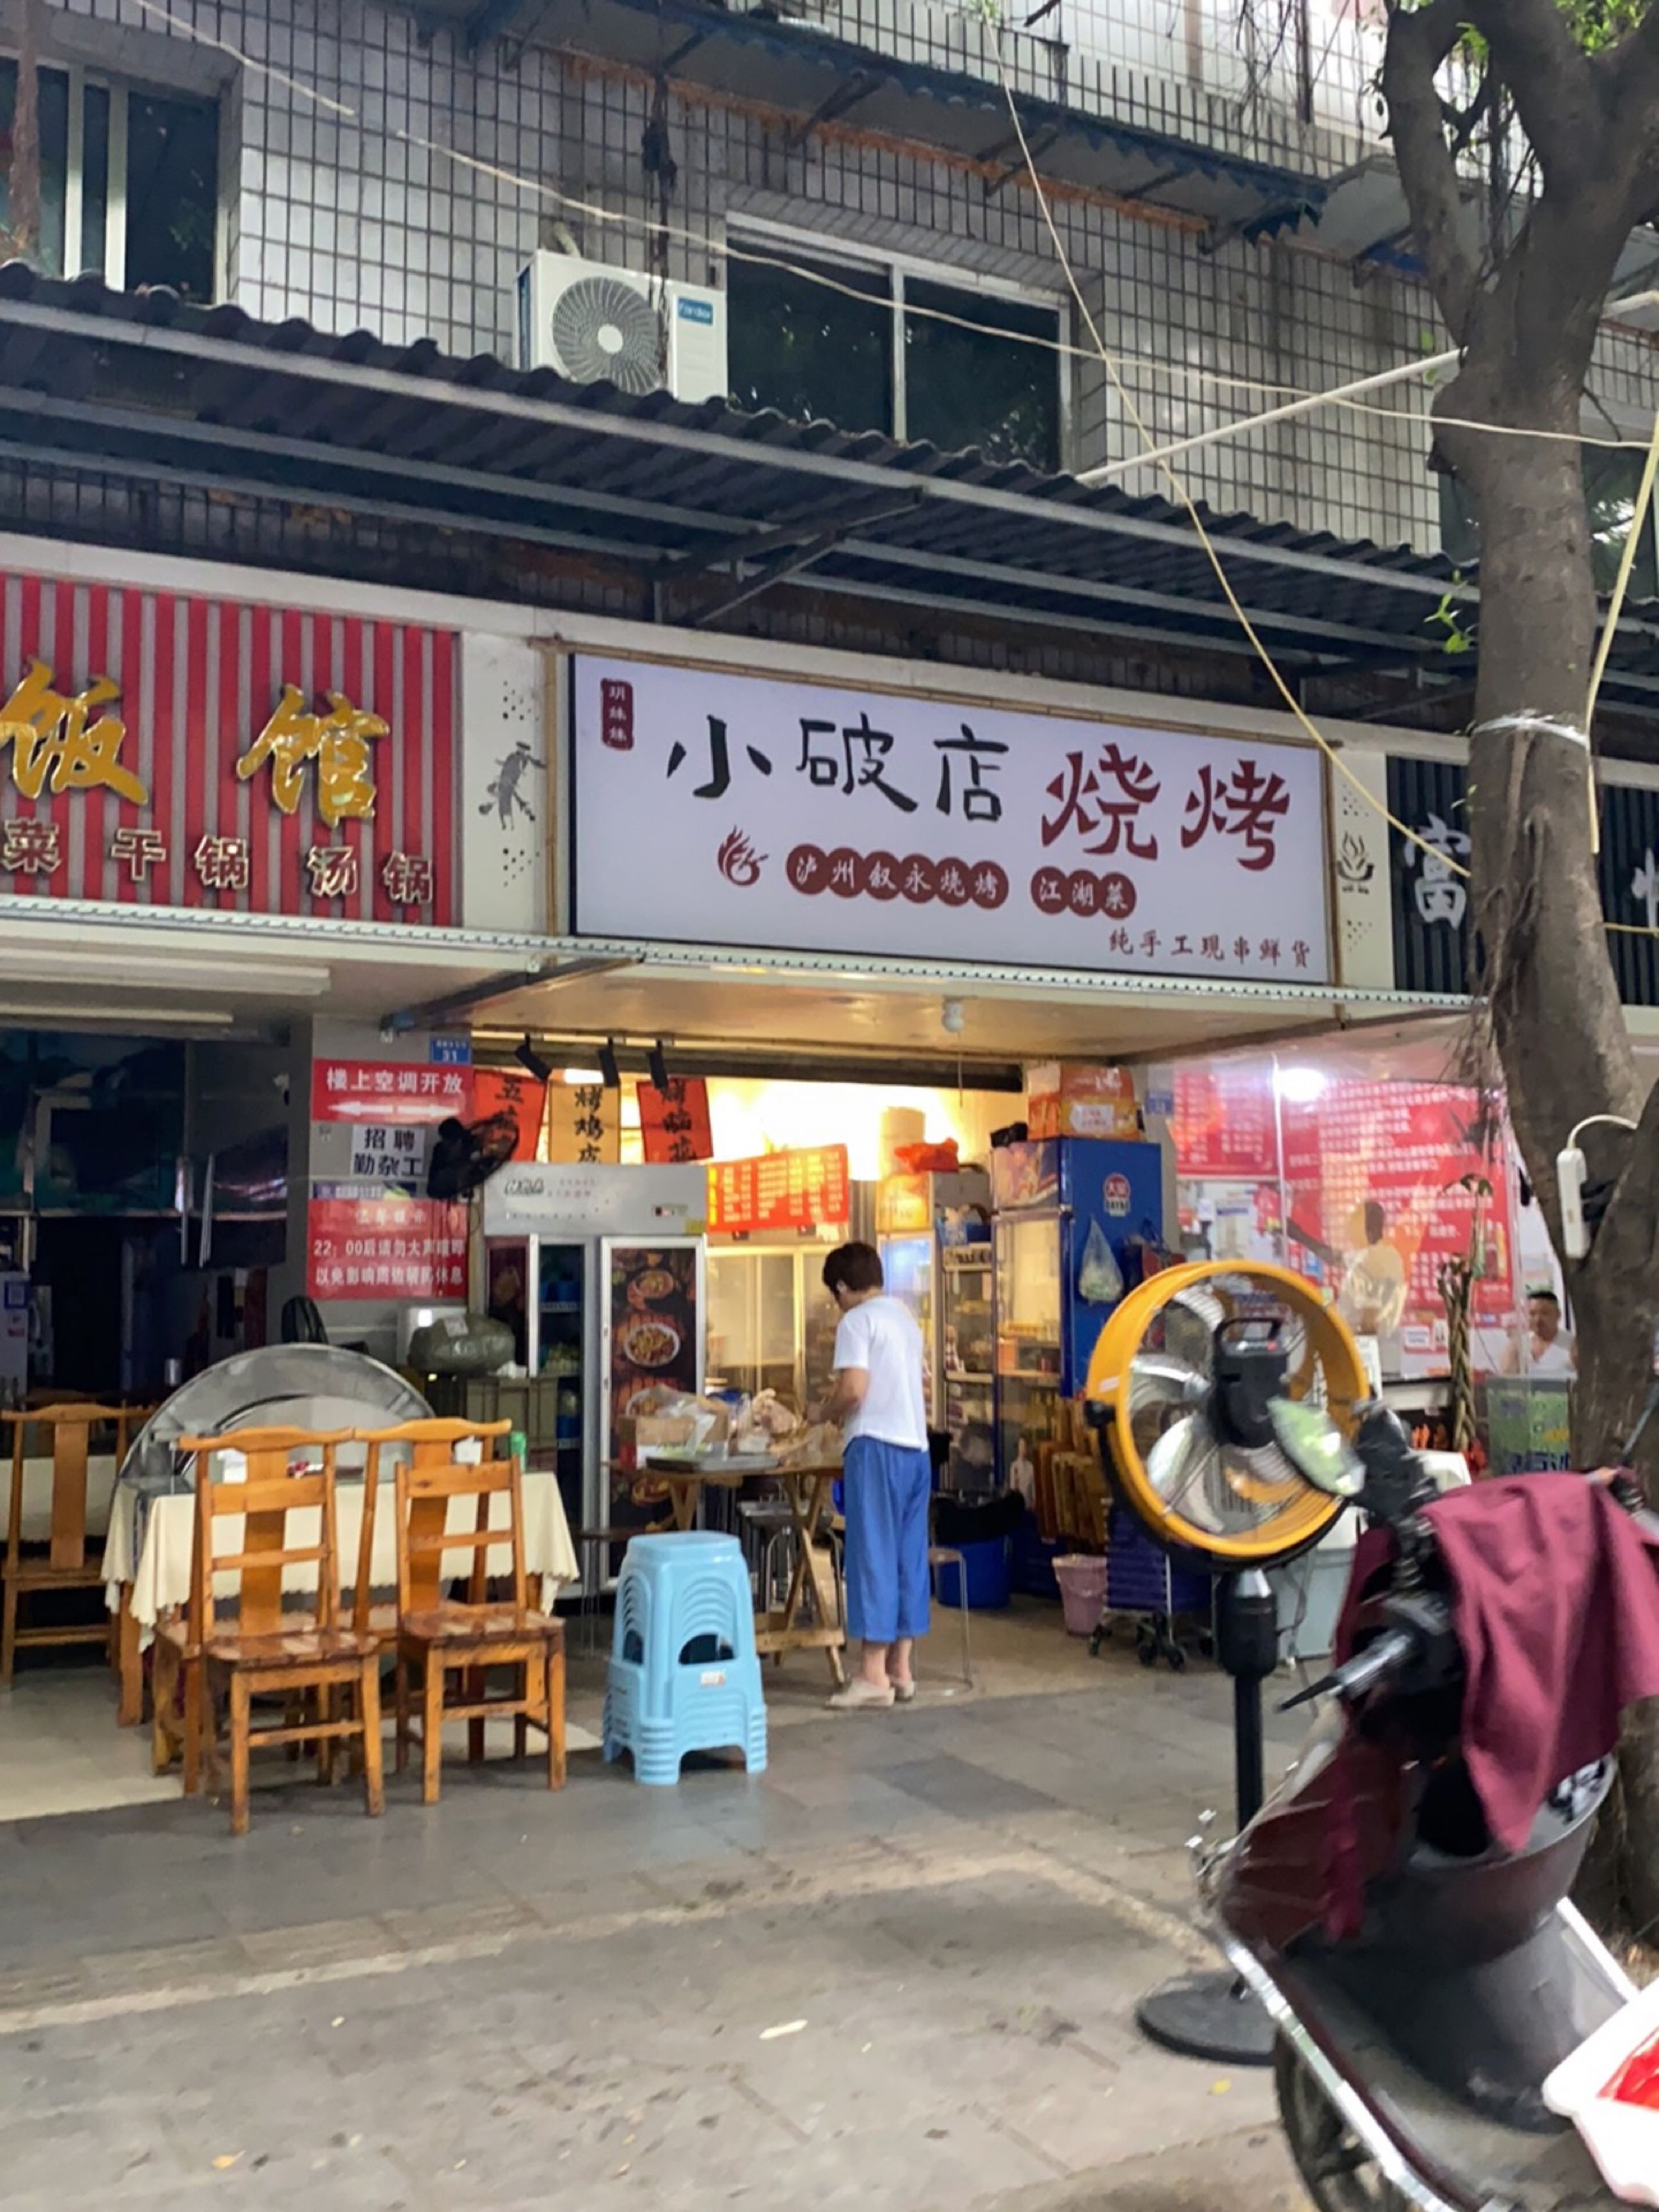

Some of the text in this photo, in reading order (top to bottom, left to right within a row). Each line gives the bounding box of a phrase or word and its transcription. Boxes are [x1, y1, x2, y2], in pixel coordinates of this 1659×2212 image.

[666, 712, 1291, 872] 小破店烧烤
[326, 1066, 463, 1094] 楼上空调开放
[364, 1127, 415, 1151] 招聘
